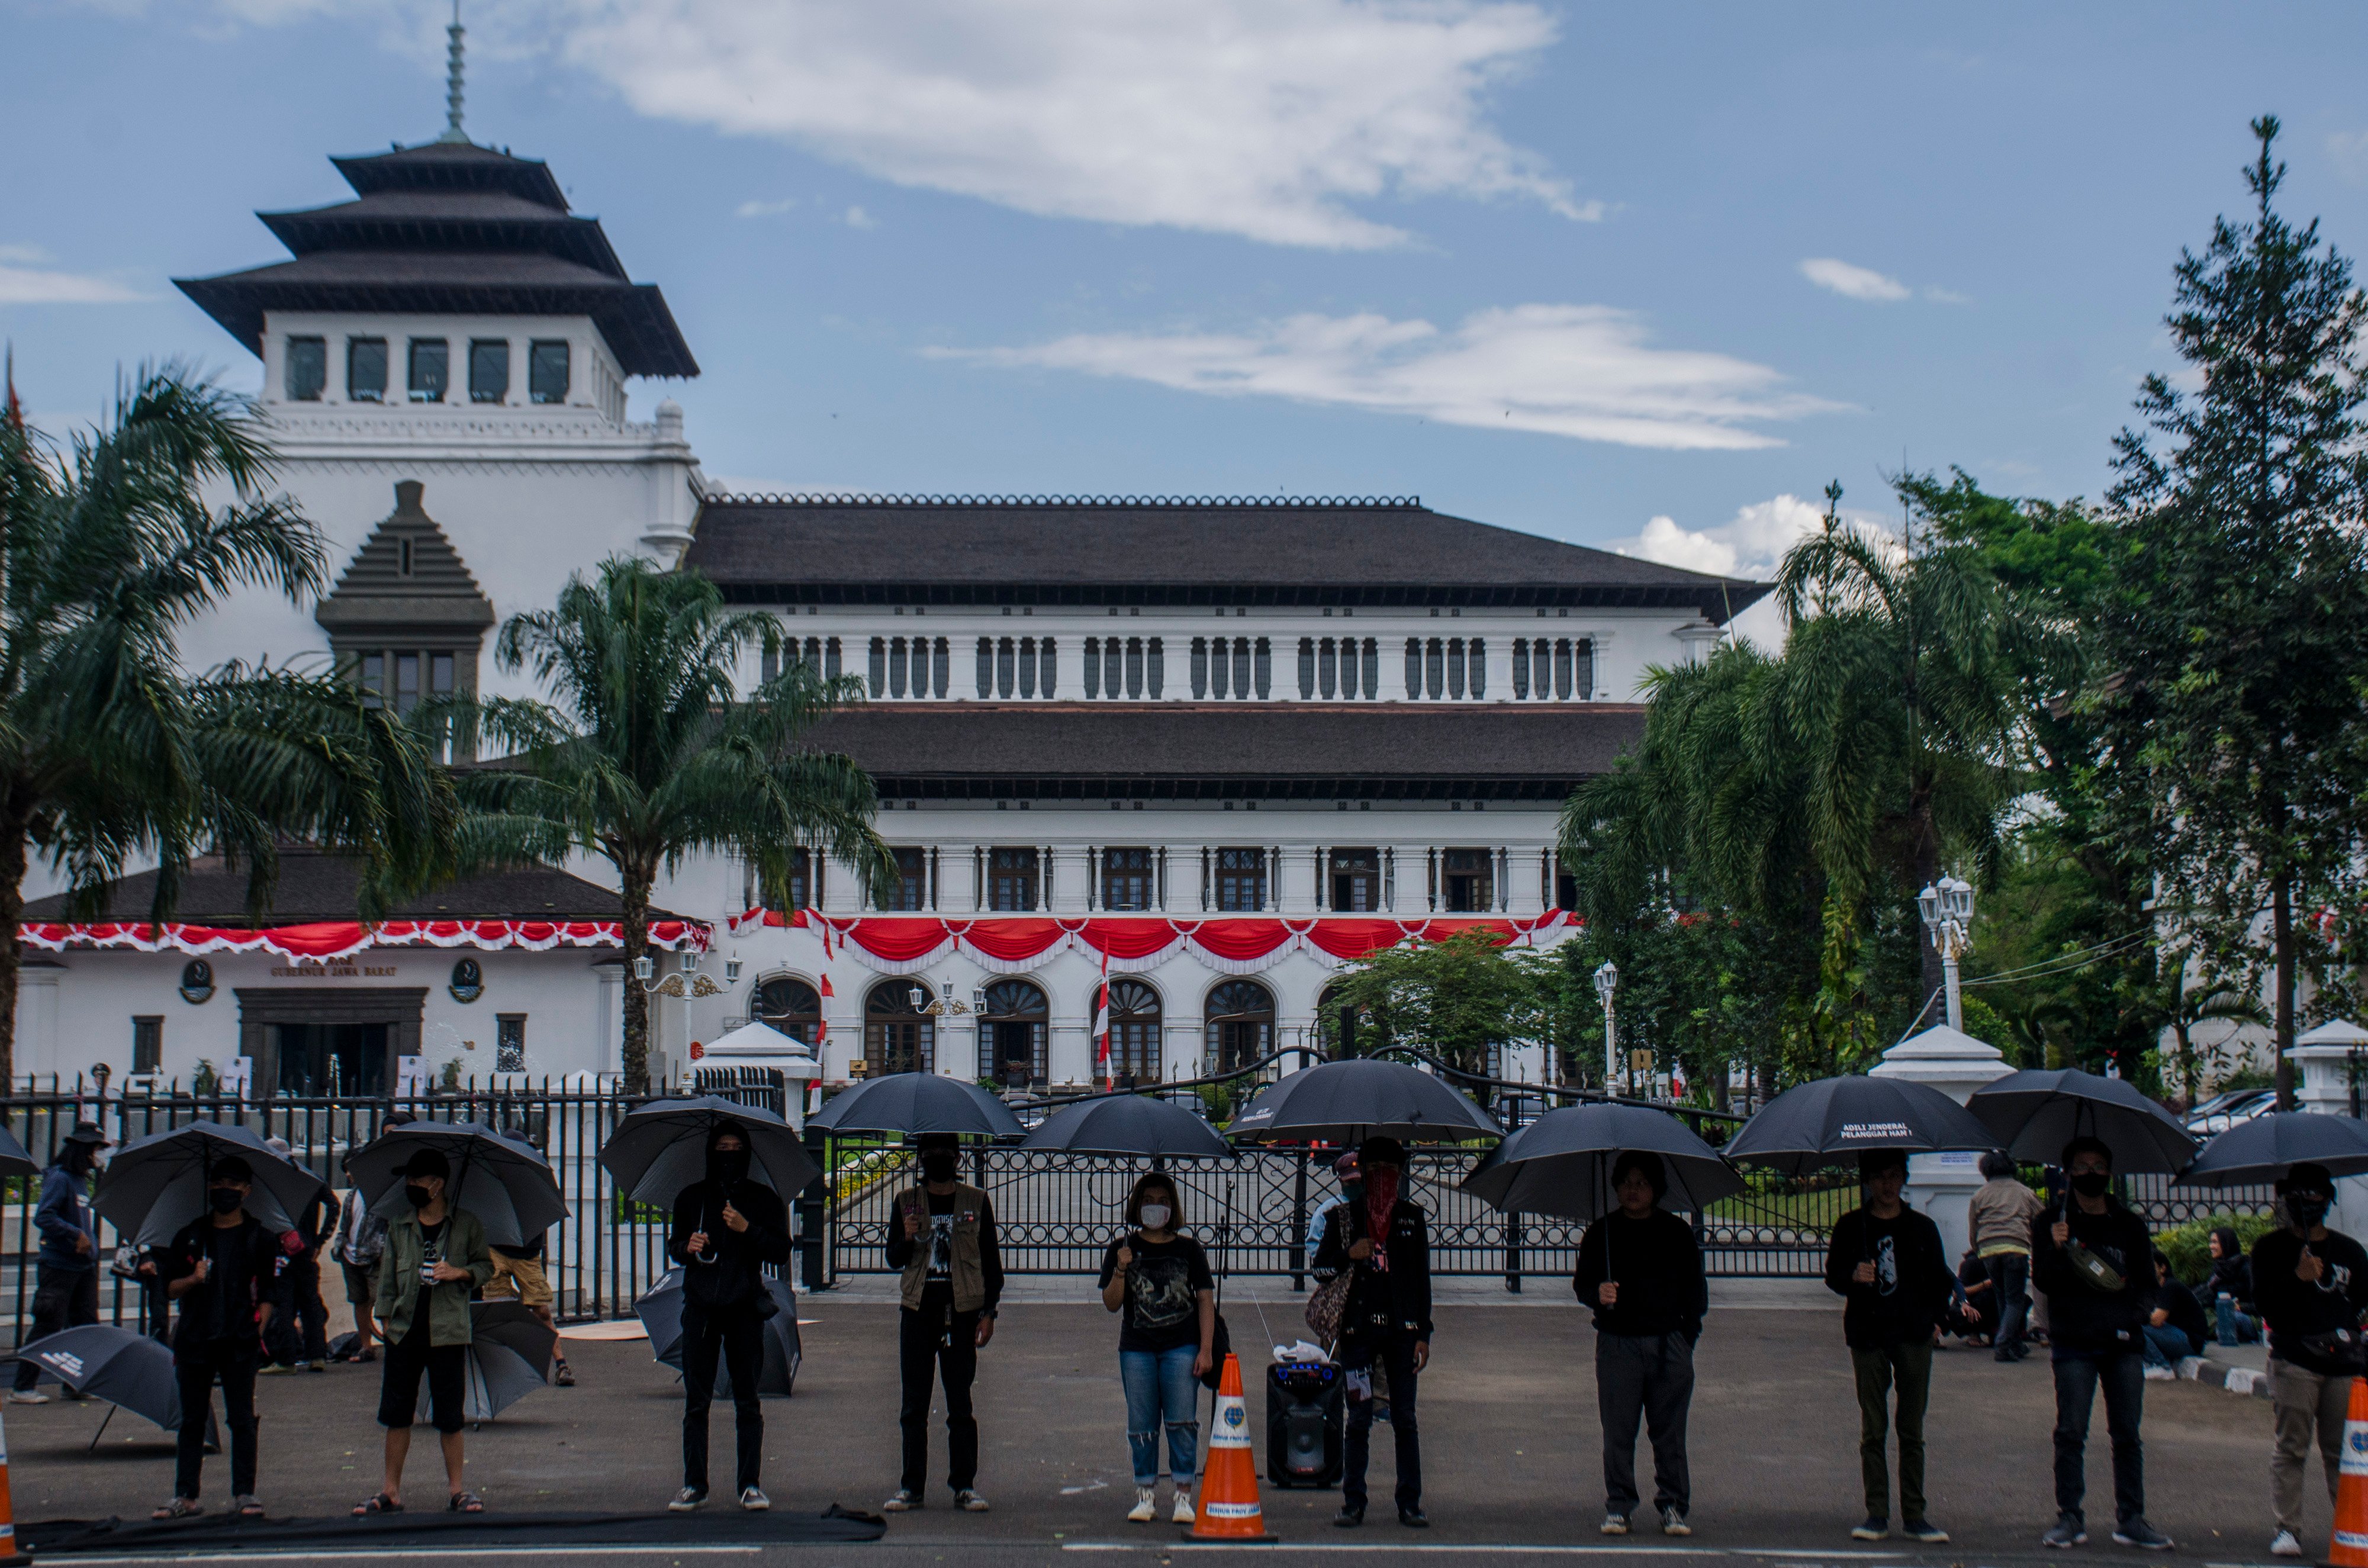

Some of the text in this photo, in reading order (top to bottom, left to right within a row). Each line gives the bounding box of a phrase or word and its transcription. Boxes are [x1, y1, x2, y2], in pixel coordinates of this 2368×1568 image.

[271, 966, 397, 976] GUBERNUR JAWA BARAT
[1841, 1130, 1888, 1138] PELANGGAR
